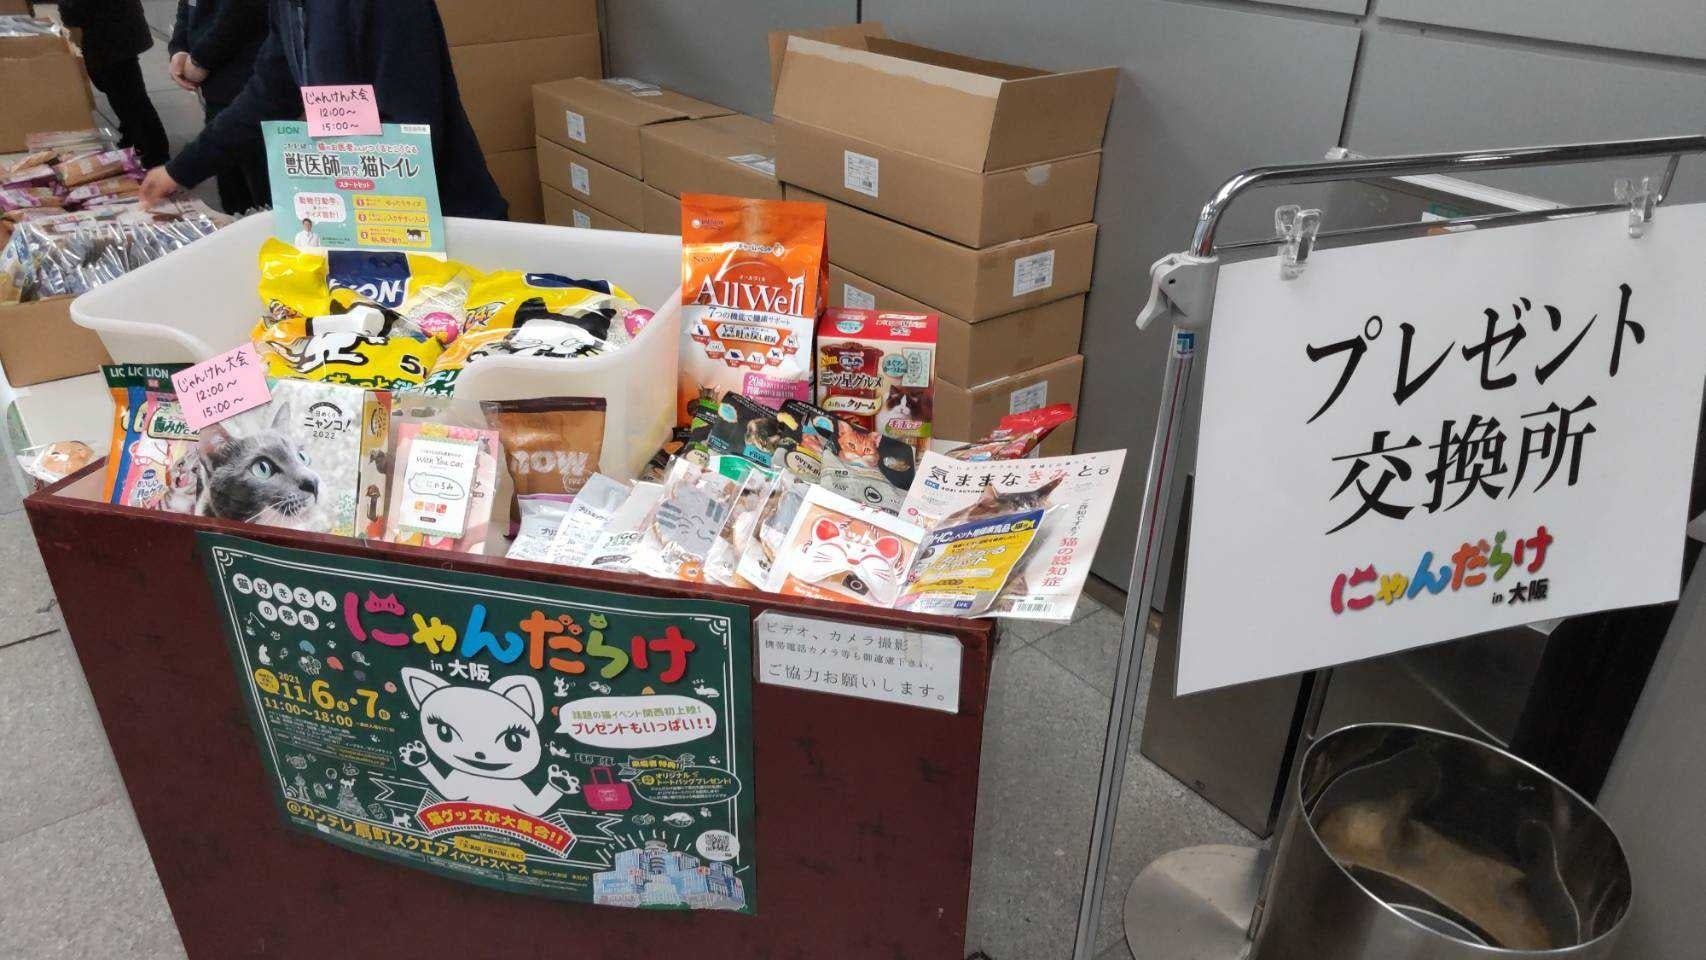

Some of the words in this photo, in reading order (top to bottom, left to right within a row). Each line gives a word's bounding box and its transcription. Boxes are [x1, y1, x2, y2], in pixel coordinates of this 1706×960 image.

[304, 88, 369, 106] じゃんけん大会
[277, 126, 300, 135] LION
[691, 270, 806, 317] AllWell
[1305, 283, 1646, 424] プレゼント
[146, 367, 169, 379] LION
[178, 349, 250, 394] じゃんけん大会
[313, 430, 336, 440] 2022
[1325, 395, 1598, 535] 交換所
[1331, 526, 1553, 615] にゃんだらけ
[1491, 591, 1504, 605] in
[1507, 578, 1549, 604] 大阪
[343, 591, 696, 683] にゃんだらけ
[430, 659, 443, 671] in
[448, 659, 491, 683] 大阪
[768, 663, 945, 701] ご協力お願いします。
[572, 718, 712, 735] プレゼントもいっぱい!!
[450, 851, 529, 875] イベントスペース
